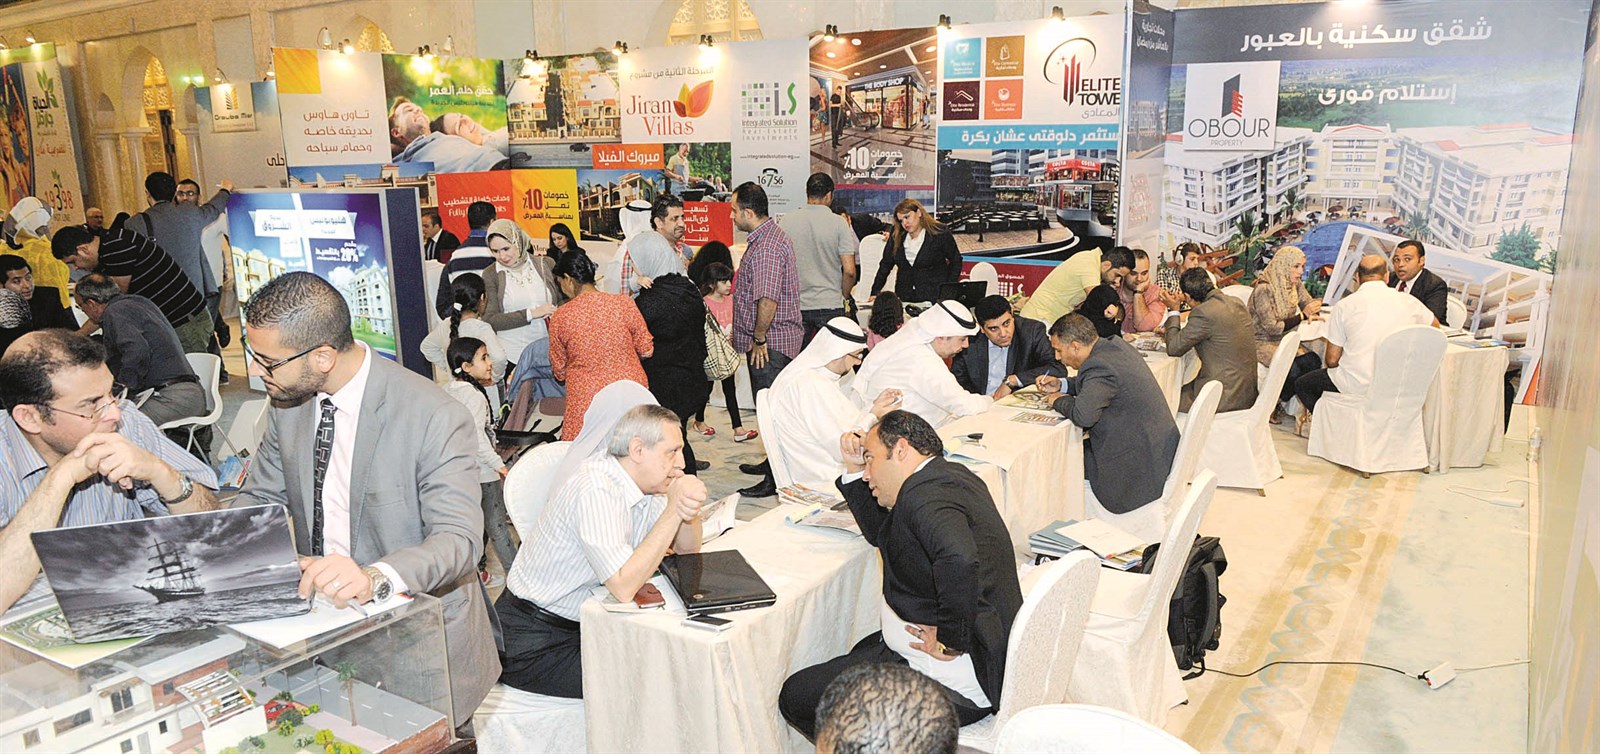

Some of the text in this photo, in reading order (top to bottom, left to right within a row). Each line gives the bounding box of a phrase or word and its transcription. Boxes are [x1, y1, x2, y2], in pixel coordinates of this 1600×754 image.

[1240, 17, 1492, 52] شقق سكنية بالعبور
[652, 70, 664, 79] من
[665, 65, 686, 79] الثانية
[429, 84, 494, 97] حقق حلم العمر
[1082, 78, 1121, 92] ELITE
[626, 95, 672, 115] Jiran
[1077, 92, 1121, 106] TOWE
[642, 115, 694, 136] Villas
[772, 118, 798, 126] Solution
[1188, 118, 1270, 138] OBOUR
[961, 126, 1119, 146] ستثمر دلوقتى عشان بكرة
[306, 142, 338, 155] سباحه
[1210, 139, 1245, 147] PROPERTY
[598, 150, 660, 166] مبروك الفيلا
[870, 150, 903, 160] خصومات
[871, 160, 903, 169] تصل
[757, 174, 783, 187] 16756
[843, 171, 869, 180] المعرض
[44, 183, 74, 211] 19398
[442, 196, 473, 207] التشطيب
[543, 191, 569, 202] خصومات
[544, 201, 570, 210] تصل
[448, 208, 466, 218] Fully
[523, 212, 544, 220] المعرض
[687, 225, 710, 234] تصل
[340, 246, 359, 262] 20%
